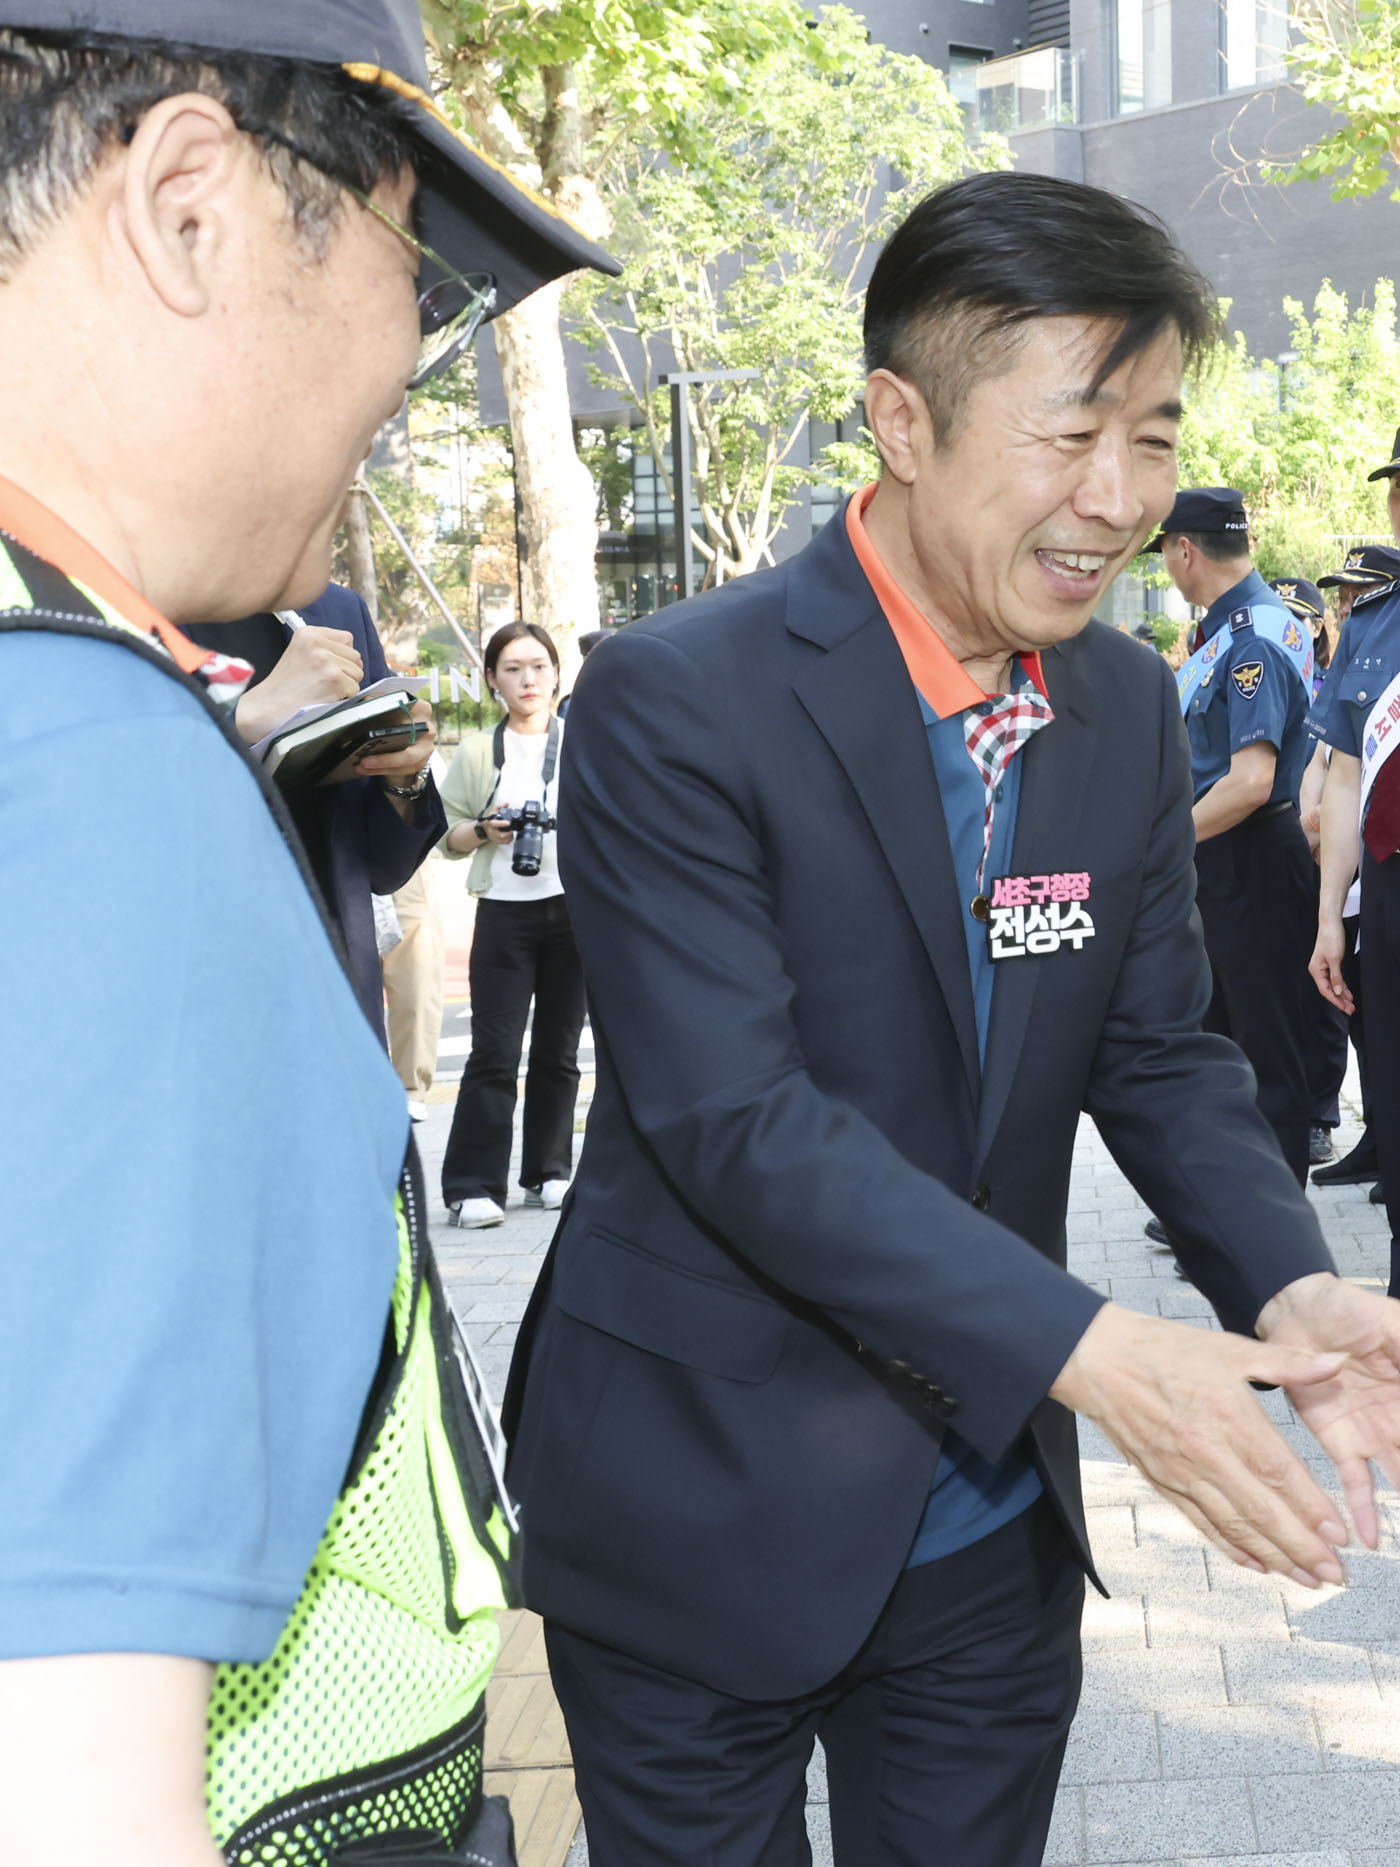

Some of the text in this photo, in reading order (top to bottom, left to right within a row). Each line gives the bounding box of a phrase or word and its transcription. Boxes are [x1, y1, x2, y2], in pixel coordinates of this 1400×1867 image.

[429, 666, 481, 704] IN
[991, 872, 1091, 908] 서초구청장
[990, 902, 1096, 960] 전성수
